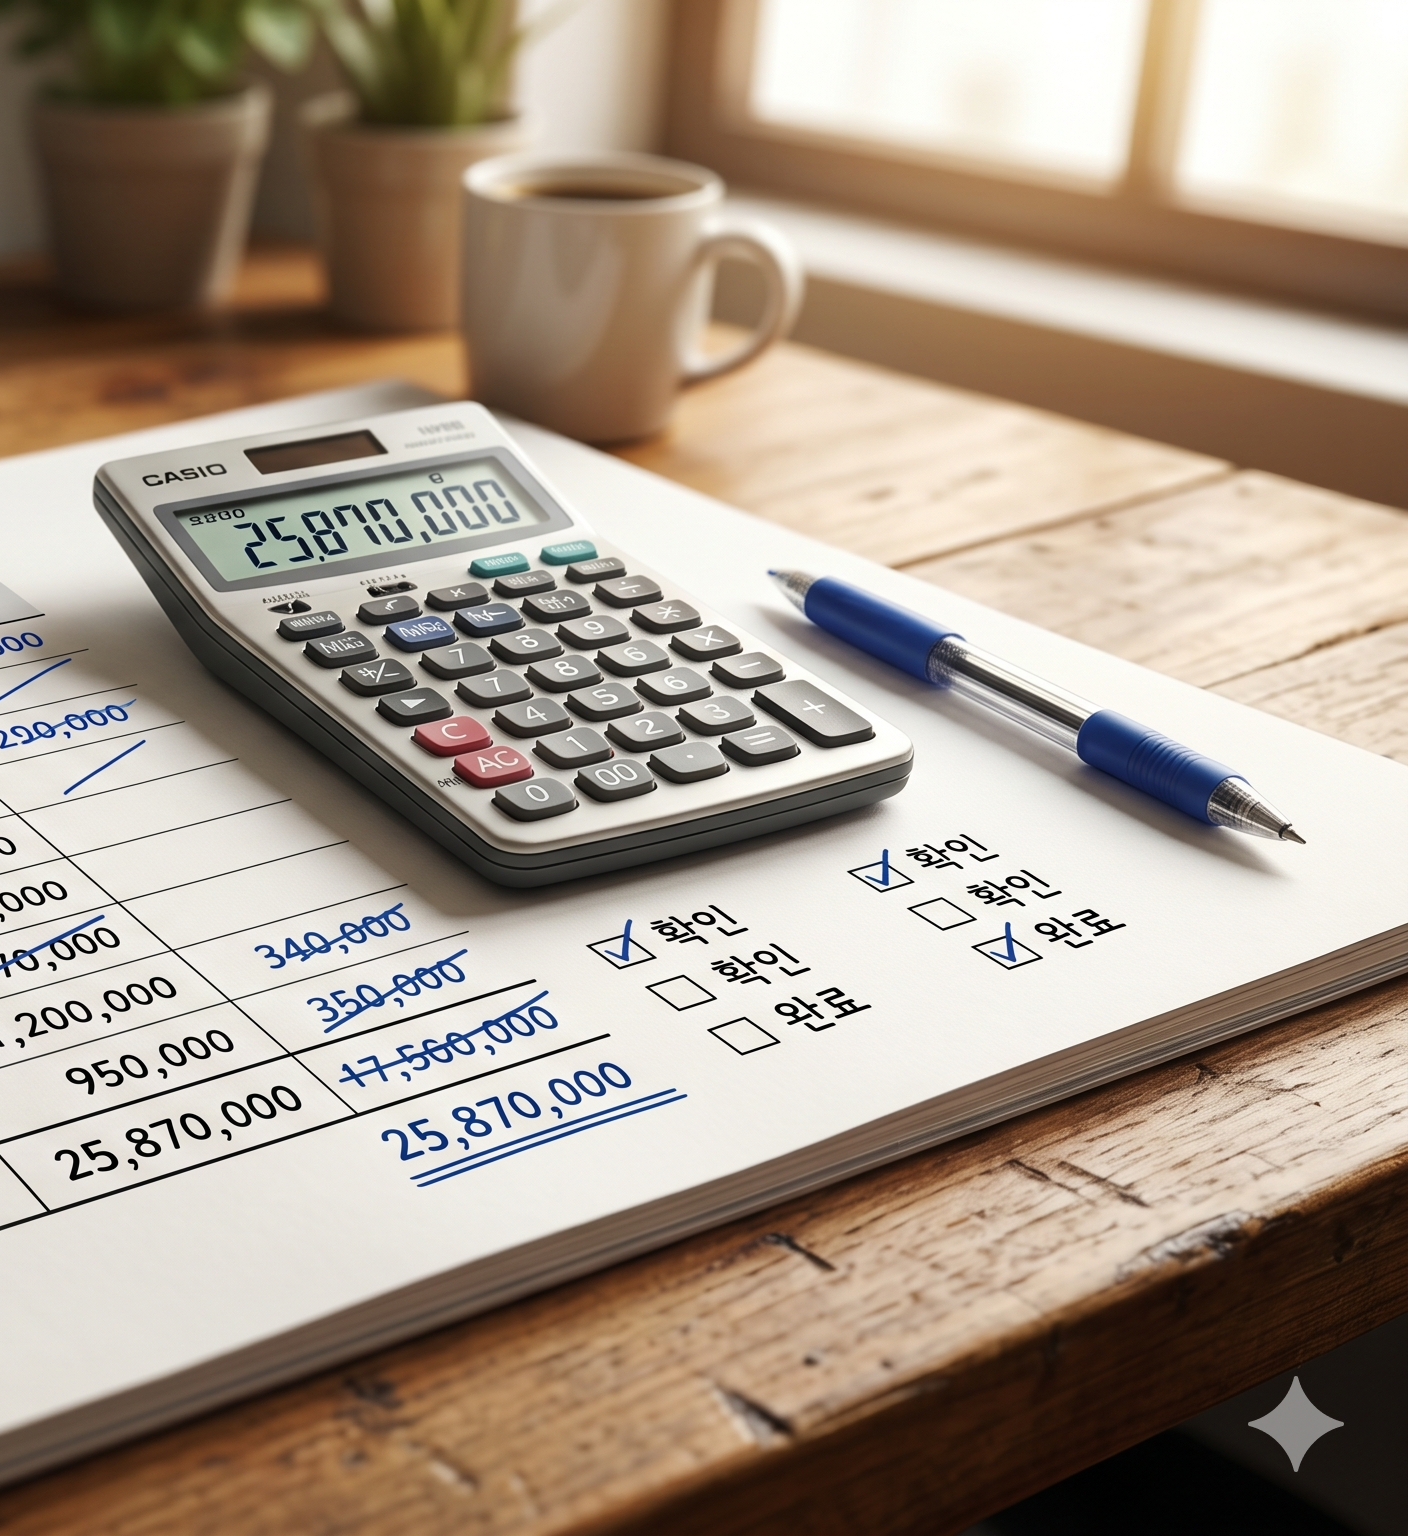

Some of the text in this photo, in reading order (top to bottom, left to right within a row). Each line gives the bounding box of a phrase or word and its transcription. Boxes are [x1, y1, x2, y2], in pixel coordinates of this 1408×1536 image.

[141, 463, 227, 487] CASIO
[232, 479, 520, 569] 25,870,000
[584, 620, 605, 635] 9
[449, 649, 465, 664] 7
[624, 646, 647, 662] 6
[554, 661, 578, 676] 8
[485, 677, 502, 692] 7
[663, 675, 687, 690] 6
[592, 688, 619, 705] 5
[527, 705, 545, 721] 4
[704, 703, 730, 719] 3
[442, 723, 467, 739] C
[635, 718, 663, 735] 2
[565, 736, 588, 752] 1
[477, 750, 519, 773] AC
[594, 763, 638, 786] 00
[906, 834, 999, 869] 확인
[966, 870, 1062, 906] 확인
[651, 905, 748, 944] 확인
[1035, 909, 1126, 948] 완료
[255, 909, 410, 968] 340,000
[711, 943, 811, 984] 확인
[307, 960, 467, 1022] 350,000
[775, 987, 871, 1032] 완료
[66, 1030, 233, 1095] 950,000
[382, 1063, 631, 1161] 25,870,000
[55, 1086, 301, 1181] 25,870,000
